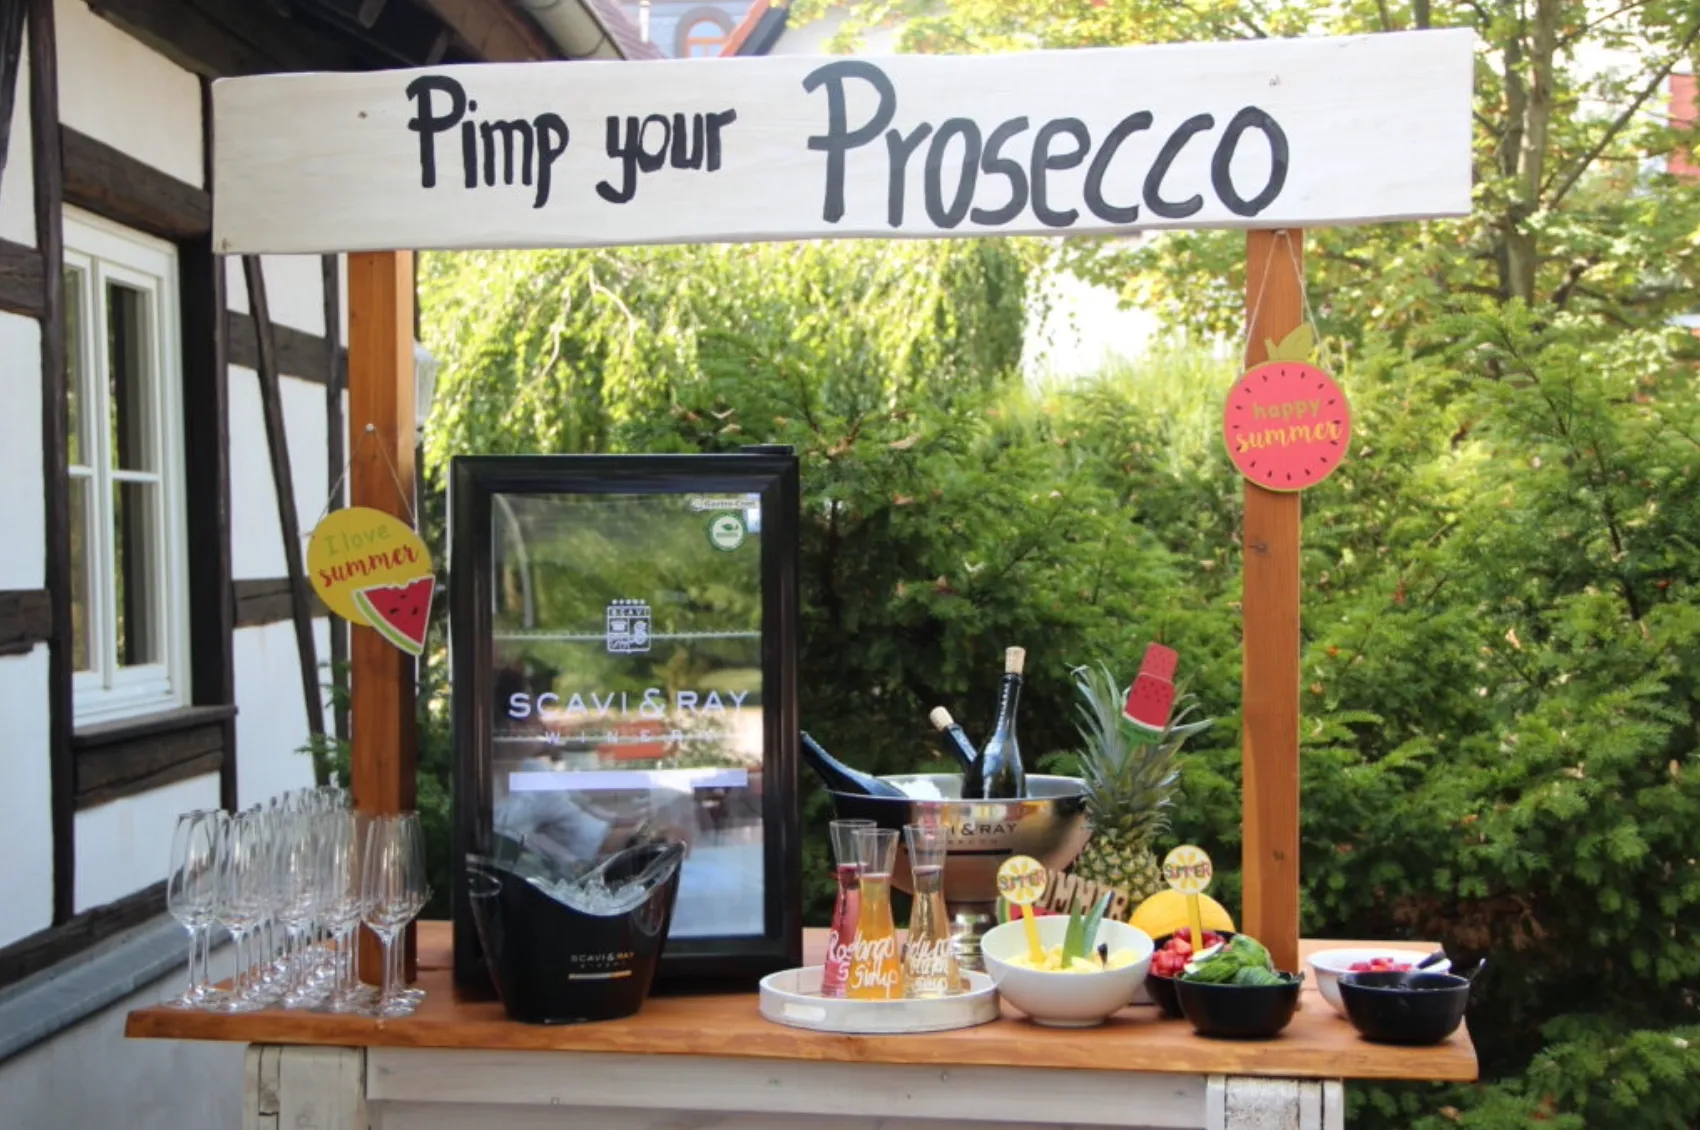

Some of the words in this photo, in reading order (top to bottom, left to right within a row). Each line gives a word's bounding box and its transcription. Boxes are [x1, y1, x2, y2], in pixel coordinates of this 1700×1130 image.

[405, 74, 570, 209] Pimp
[595, 108, 737, 204] your
[801, 60, 1290, 229] Prosecco
[1252, 399, 1321, 422] happy
[1235, 421, 1343, 453] summer
[324, 535, 339, 557] I
[341, 524, 391, 550] love
[318, 544, 420, 588] summer
[508, 691, 628, 719] SCAVI
[677, 690, 750, 714] RAY
[980, 823, 1017, 835] RAY
